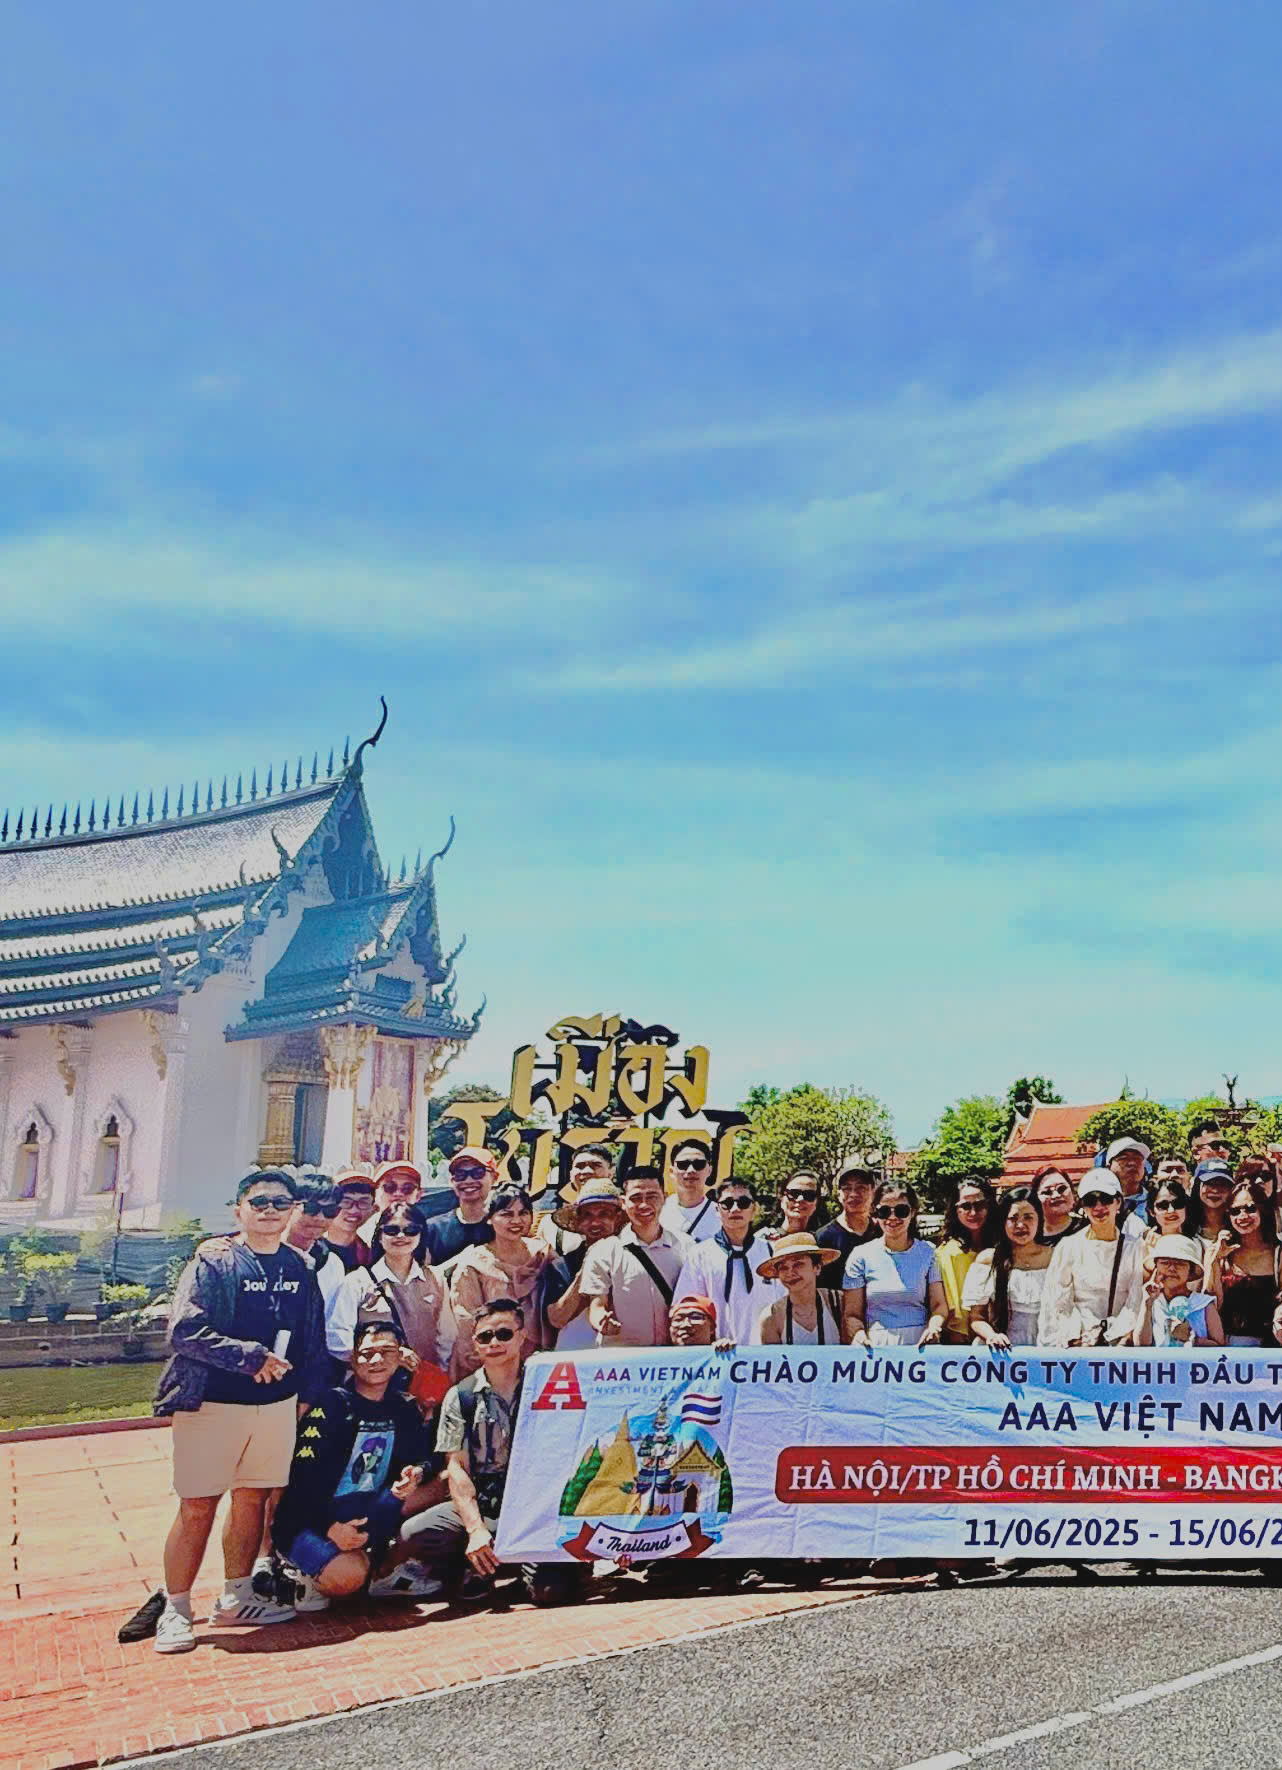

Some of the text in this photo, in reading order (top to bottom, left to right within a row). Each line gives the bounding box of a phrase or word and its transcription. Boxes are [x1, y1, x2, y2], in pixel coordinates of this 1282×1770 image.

[594, 1366, 721, 1382] AAA VIETNAM
[729, 1354, 818, 1384] CHÀO
[831, 1353, 927, 1384] MỪNG
[940, 1355, 1028, 1384] CÔNG
[1041, 1361, 1077, 1384] TY
[1088, 1361, 1176, 1385] TNHH
[1190, 1353, 1254, 1385] ĐẦU
[997, 1401, 1078, 1432] AAA
[1094, 1394, 1183, 1440] VIỆT
[788, 1458, 836, 1490] HÀ
[842, 1458, 952, 1497] NỘI/TP
[955, 1454, 1004, 1491] HỒ
[1009, 1459, 1066, 1490] CHÍ
[1071, 1465, 1161, 1491] MINH
[606, 1534, 672, 1553] Thailand
[964, 1518, 1139, 1548] 11/06/2025
